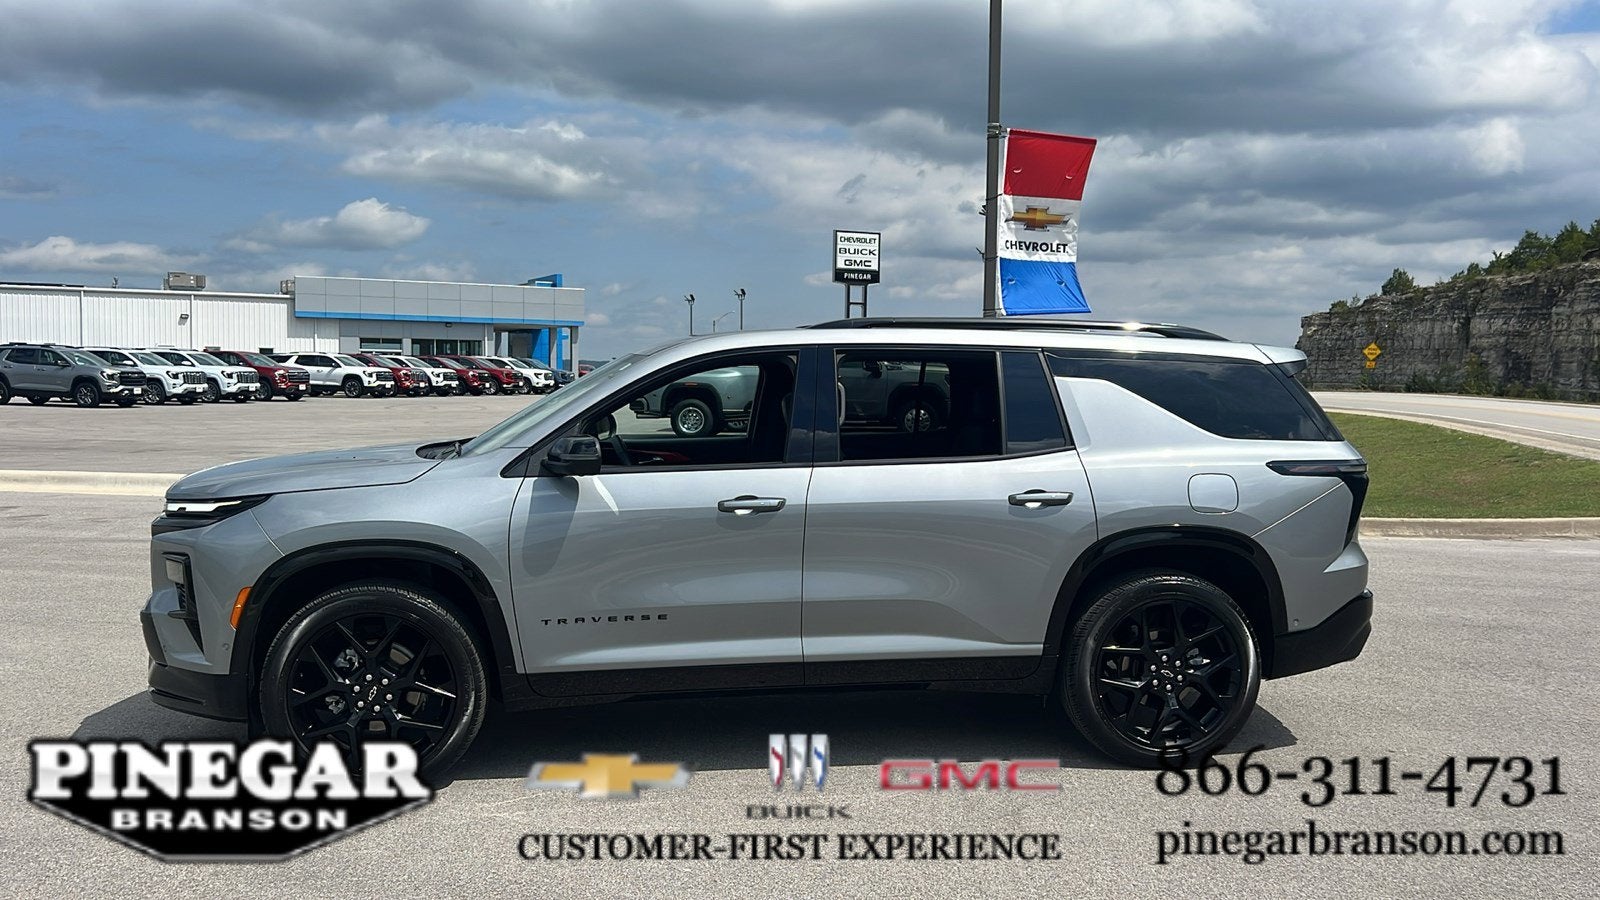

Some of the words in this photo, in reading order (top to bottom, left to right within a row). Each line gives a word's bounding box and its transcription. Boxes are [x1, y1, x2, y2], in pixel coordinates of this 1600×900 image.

[839, 235, 877, 245] CHEVROLET
[838, 247, 877, 256] BUICK
[1004, 239, 1068, 254] CHEVROLET
[844, 258, 872, 268] GMC
[844, 272, 872, 281] PINEGAR
[540, 614, 669, 626] TRAVERSE
